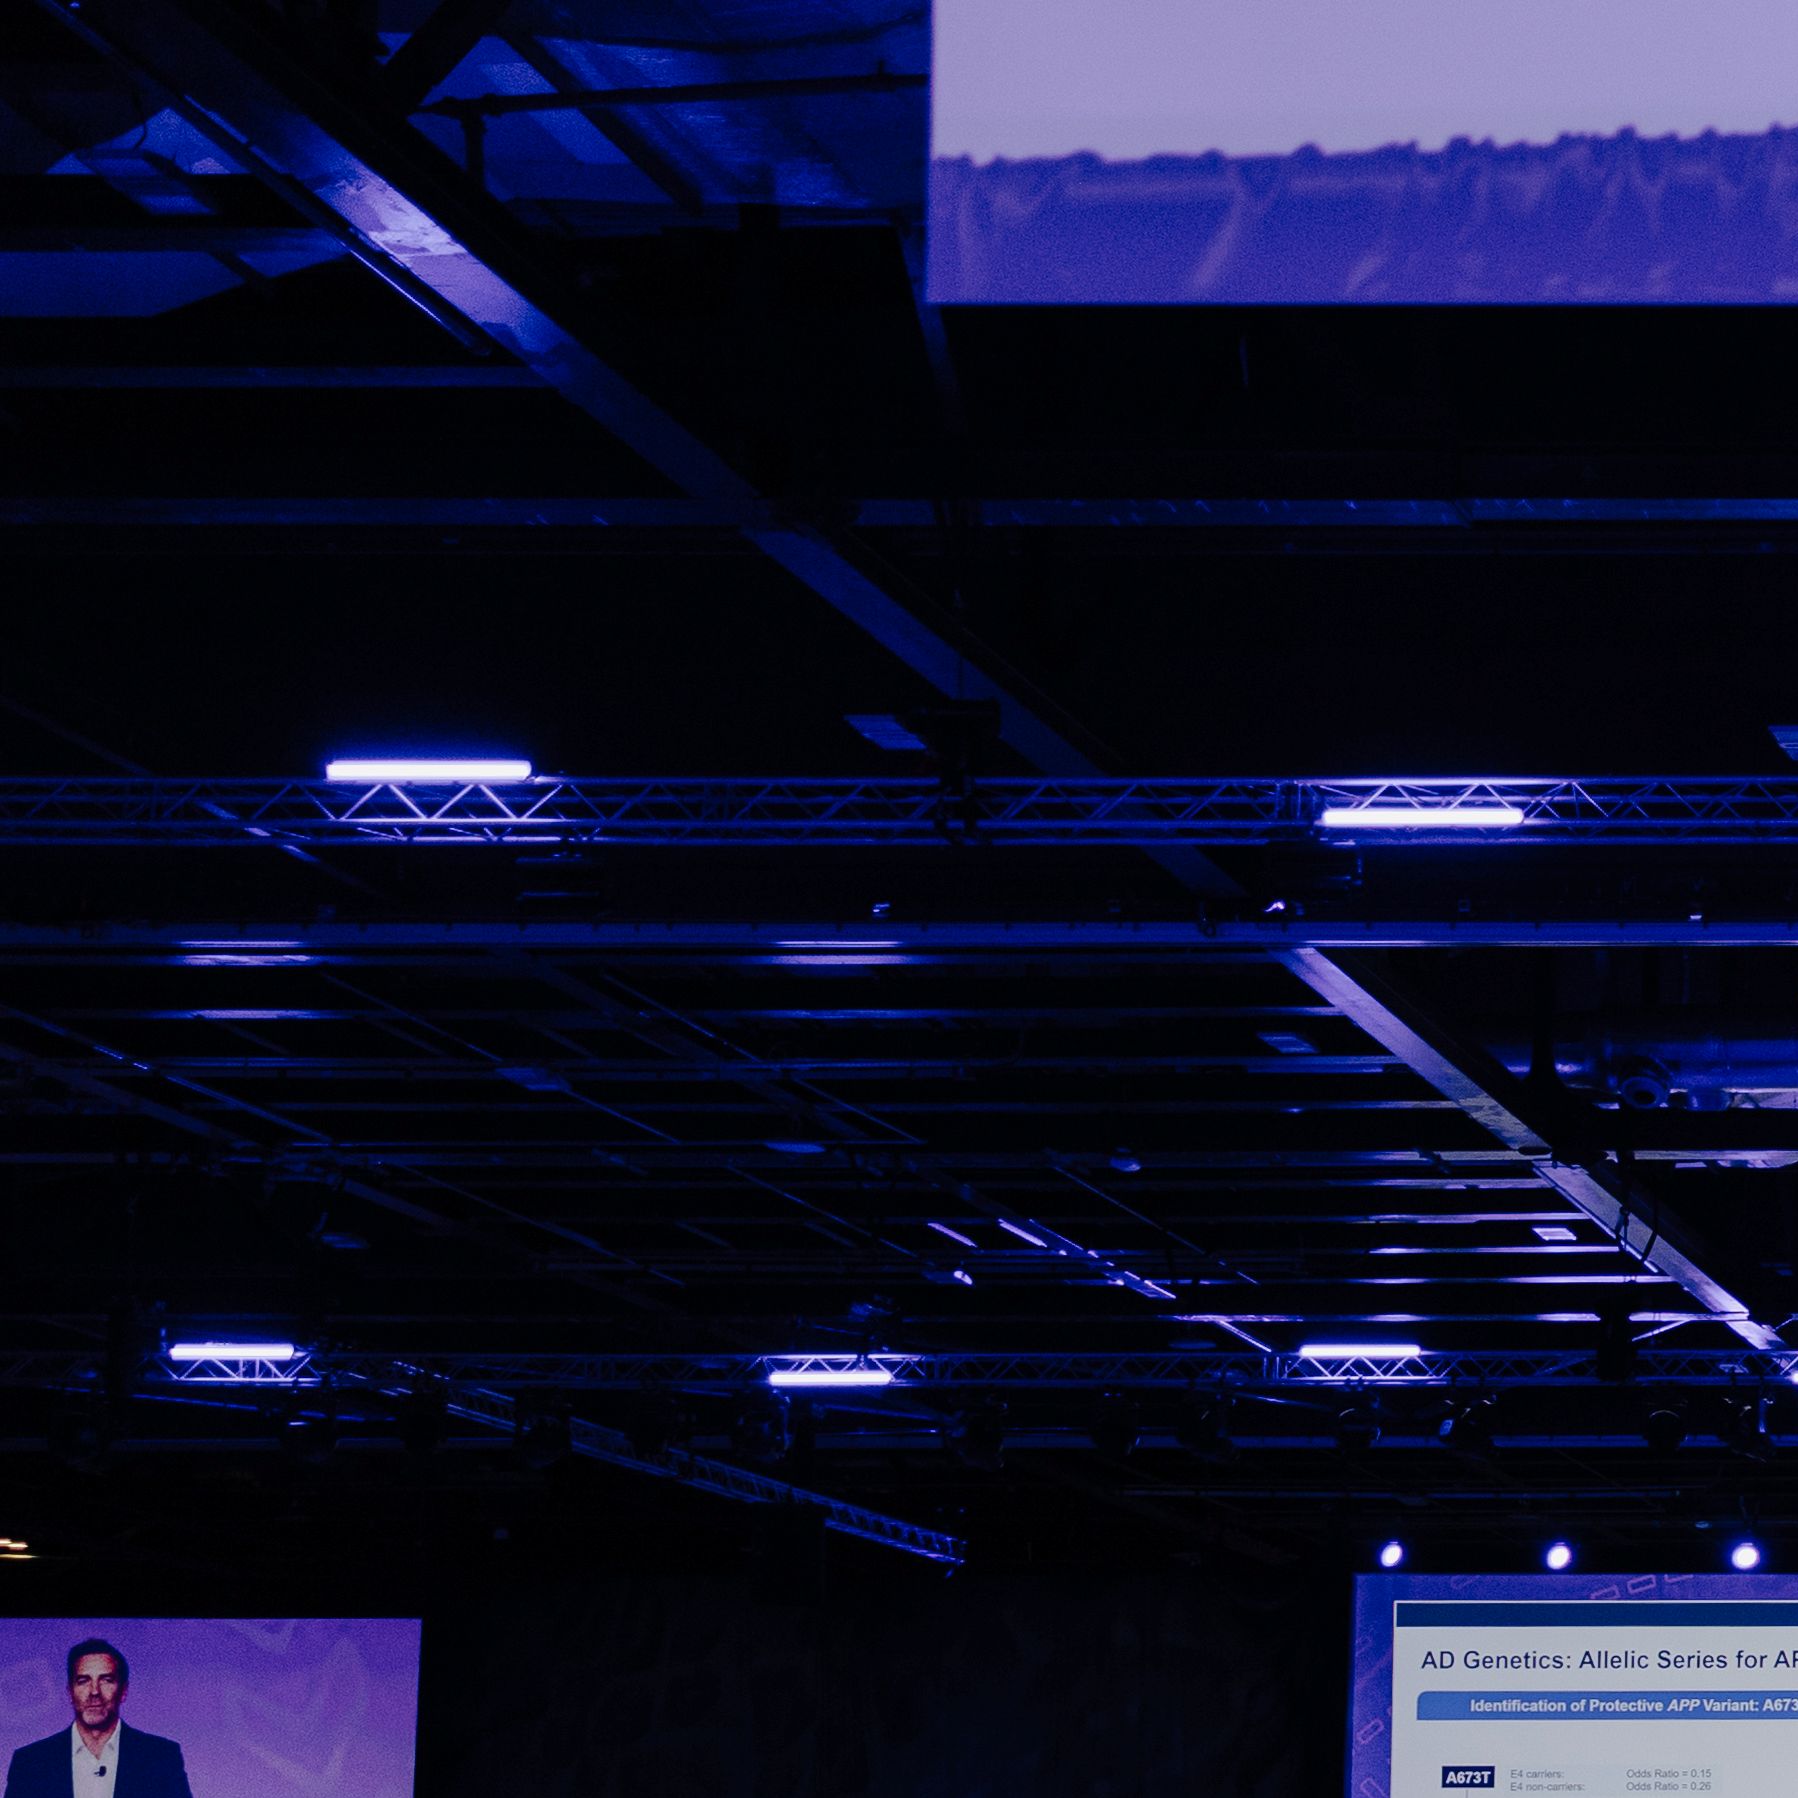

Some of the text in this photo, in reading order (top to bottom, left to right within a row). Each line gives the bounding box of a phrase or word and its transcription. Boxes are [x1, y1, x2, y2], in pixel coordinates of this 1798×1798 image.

[1421, 1651, 1455, 1669] AD
[1464, 1650, 1571, 1669] Genetics:
[1579, 1650, 1649, 1669] Allelic
[1657, 1650, 1728, 1669] Series
[1736, 1650, 1768, 1669] for
[1470, 1699, 1566, 1712] Identification
[1570, 1699, 1587, 1712] of
[1589, 1699, 1663, 1712] Protective
[1666, 1699, 1701, 1712] APP
[1702, 1699, 1759, 1711] Variant:
[1446, 1771, 1491, 1784] A673T
[1510, 1769, 1523, 1779] E4
[1626, 1768, 1712, 1778] Odds Ratio 0.15
[1510, 1782, 1523, 1792] E4
[1626, 1781, 1711, 1791] Odds Ratio 0.26
